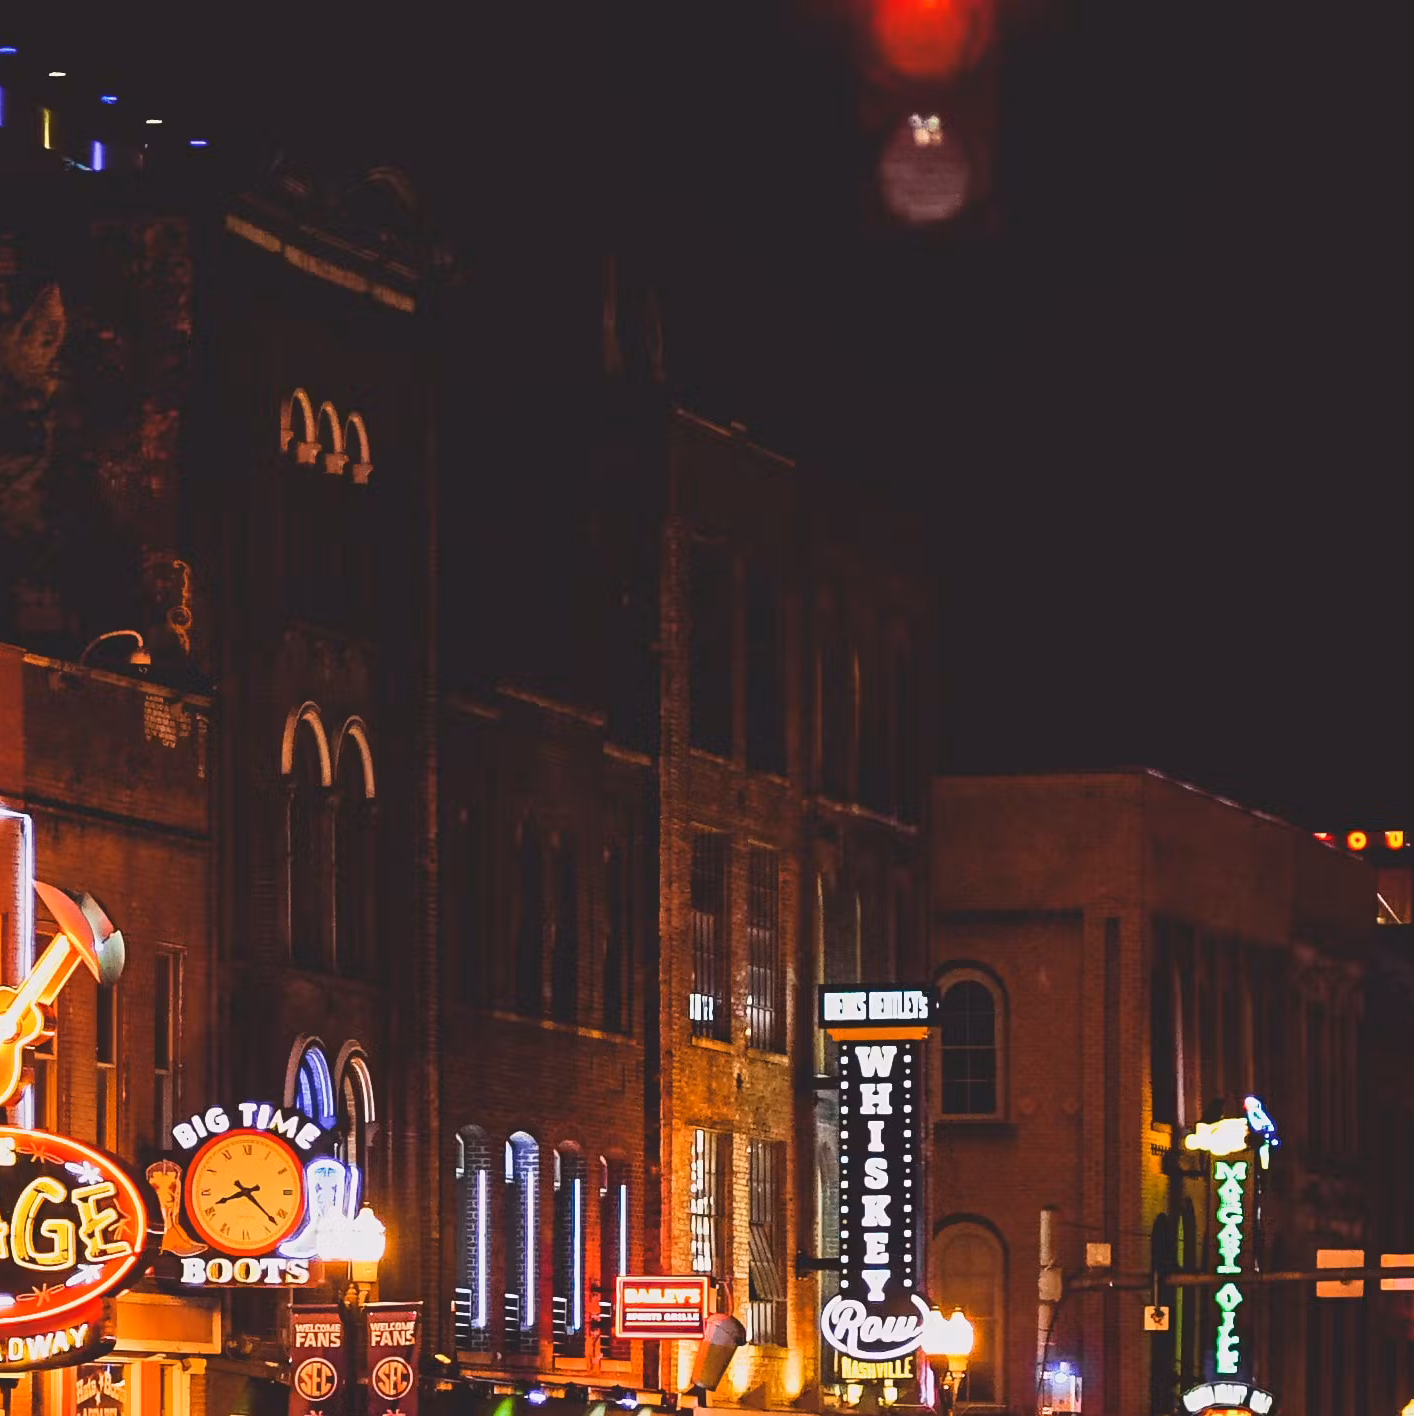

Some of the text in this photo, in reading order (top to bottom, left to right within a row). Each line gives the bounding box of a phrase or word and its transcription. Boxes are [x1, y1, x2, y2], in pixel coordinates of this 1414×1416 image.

[172, 1102, 322, 1150] BIG TIME
[855, 1045, 898, 1302] WHISKEY
[180, 1257, 309, 1285] BOOTS
[295, 1324, 341, 1332] WELCOME
[370, 1321, 416, 1331] WELCOME
[370, 1331, 416, 1346] FANS
[833, 1298, 923, 1352] Row
[295, 1332, 341, 1348] FANS
[299, 1362, 333, 1397] SEC
[377, 1361, 408, 1396] SEC
[841, 1356, 914, 1378] NASHVILLE
